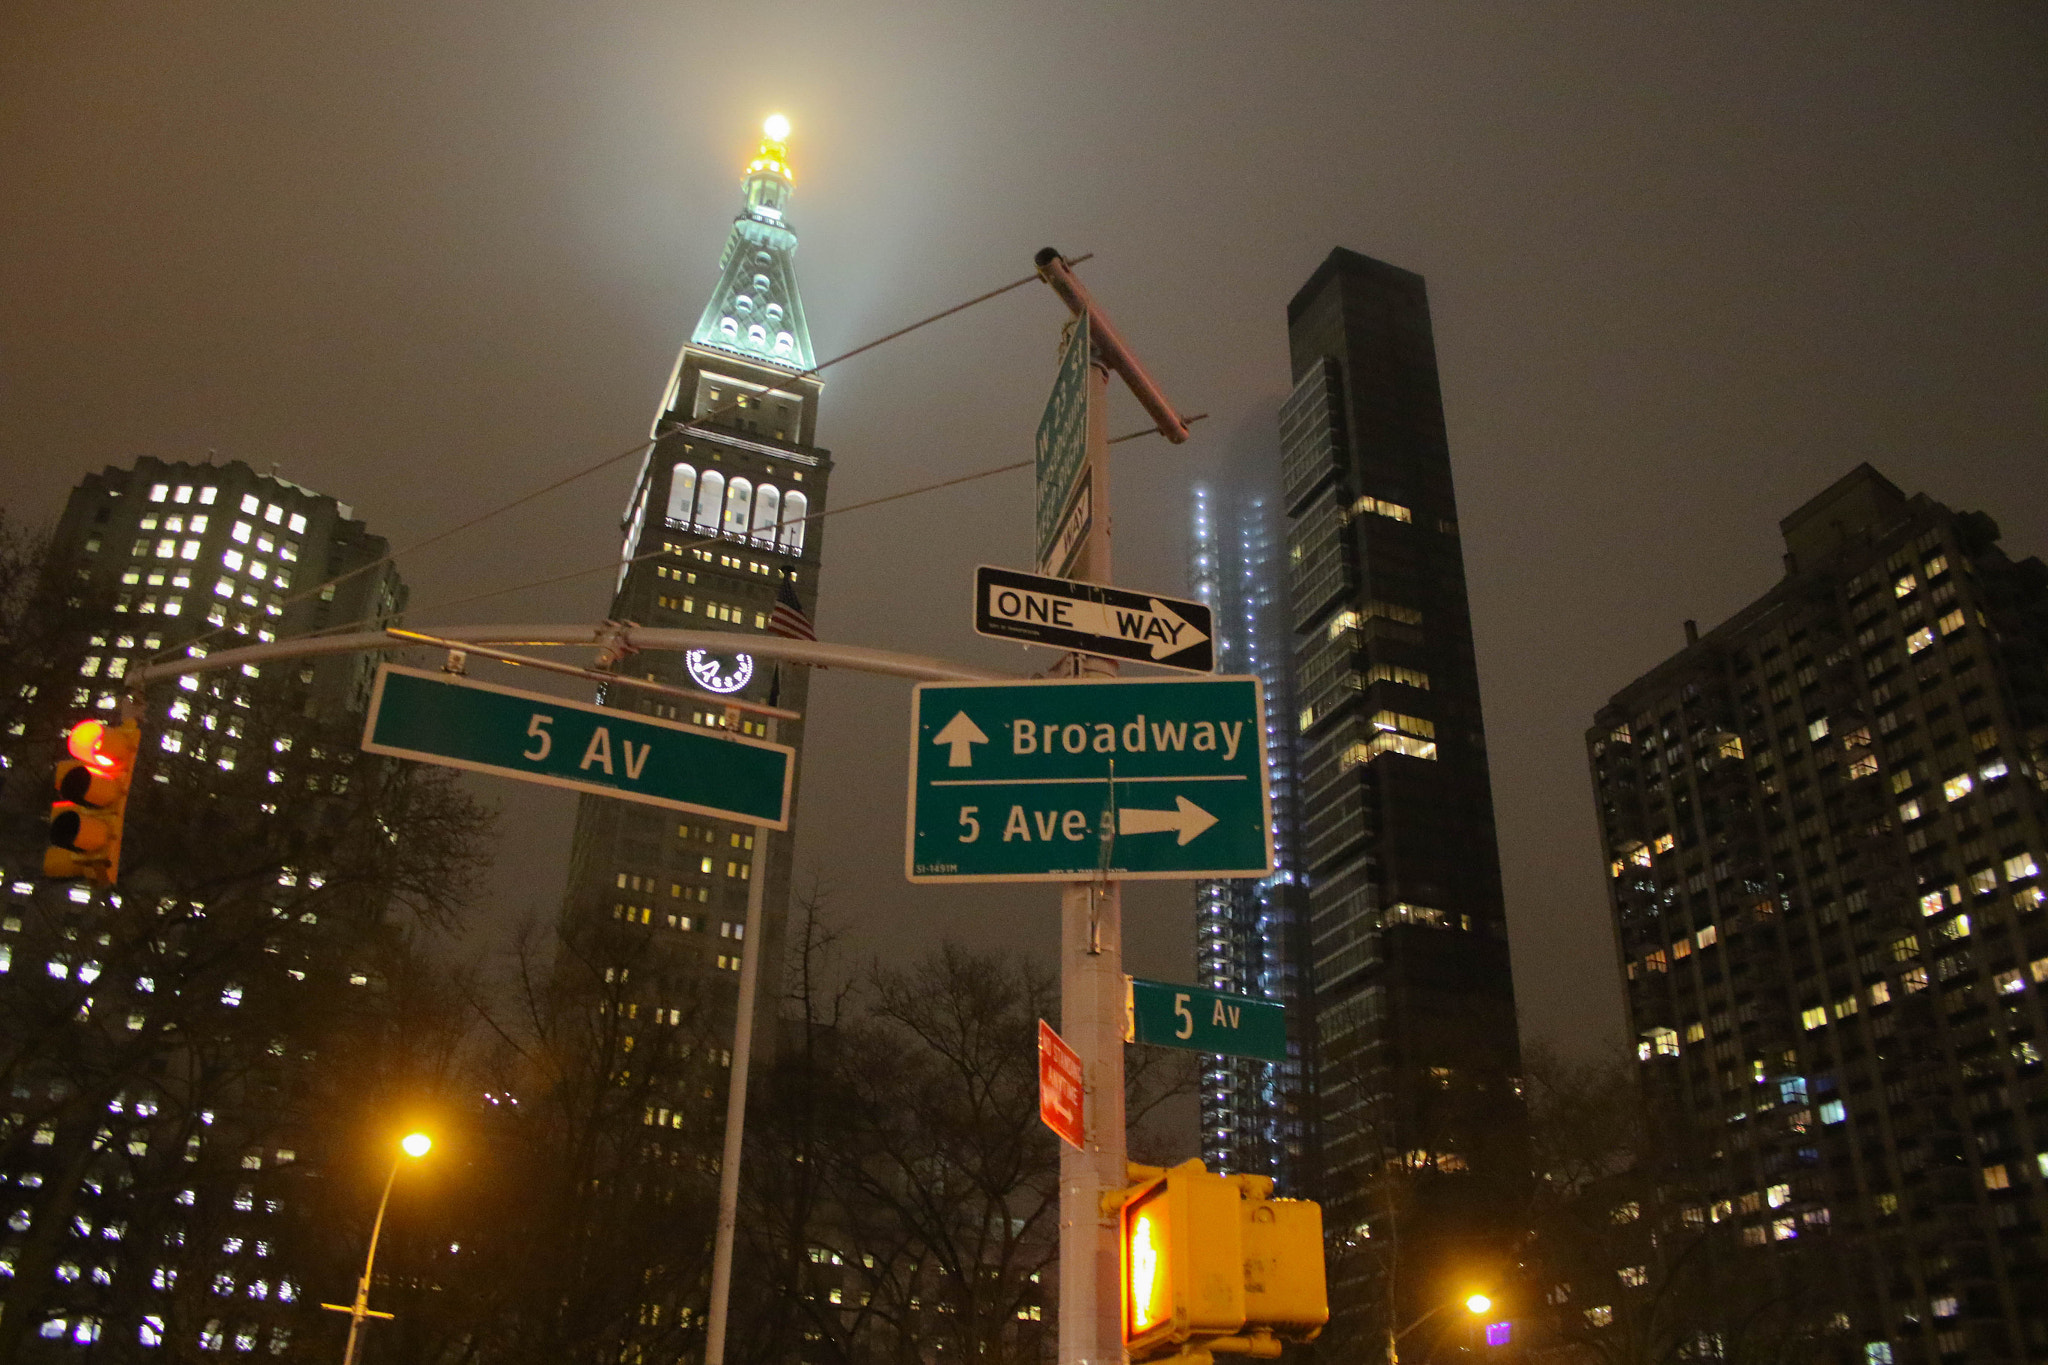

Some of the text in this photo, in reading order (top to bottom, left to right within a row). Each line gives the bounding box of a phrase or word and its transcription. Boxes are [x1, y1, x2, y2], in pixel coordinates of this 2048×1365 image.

[998, 591, 1186, 646] ONE WAY
[523, 713, 651, 780] 5 Av
[1012, 714, 1244, 762] Broadway
[958, 805, 1088, 844] 5 Ave
[1174, 993, 1241, 1040] 5 Av
